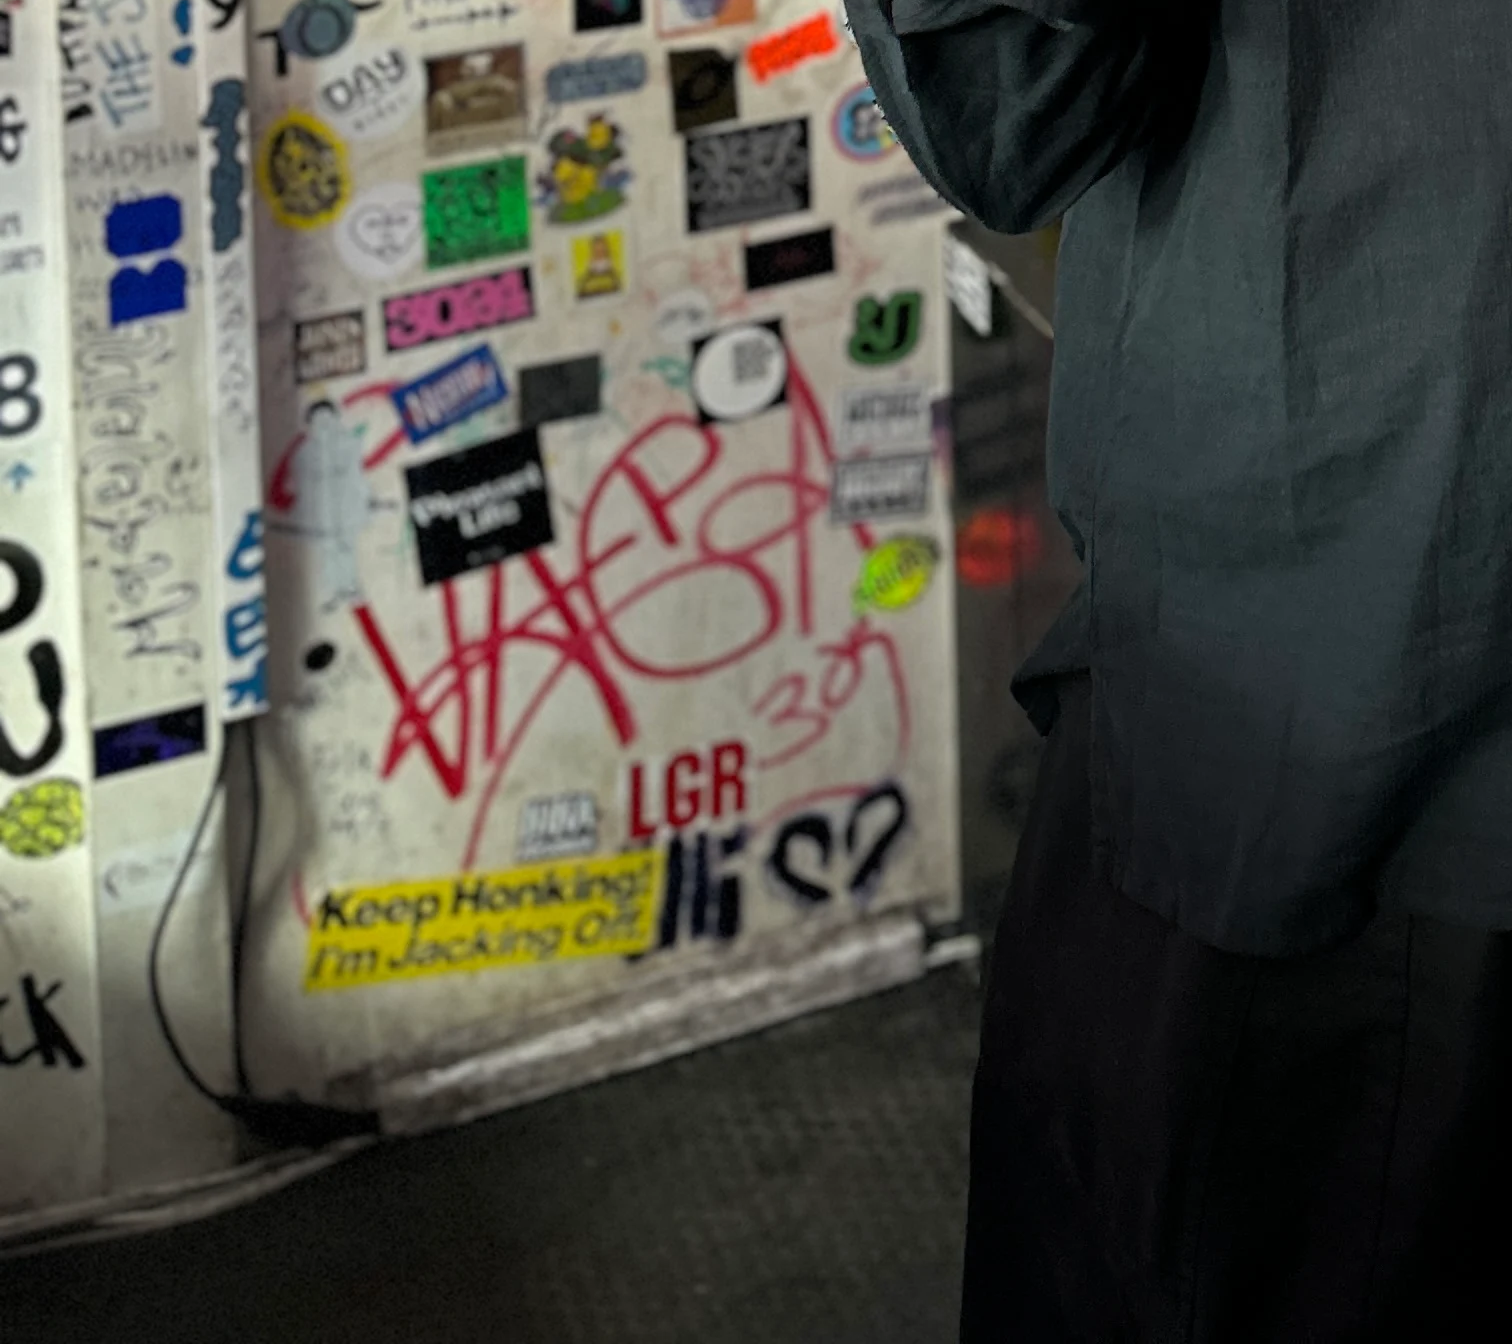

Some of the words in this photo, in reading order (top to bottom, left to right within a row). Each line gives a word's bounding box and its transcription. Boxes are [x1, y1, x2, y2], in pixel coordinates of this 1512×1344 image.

[322, 49, 404, 112] DAY
[628, 742, 747, 838] LGR
[319, 883, 442, 931] Keep
[454, 858, 653, 917] Honking!
[310, 942, 382, 980] I'm
[387, 922, 566, 967] Jacking
